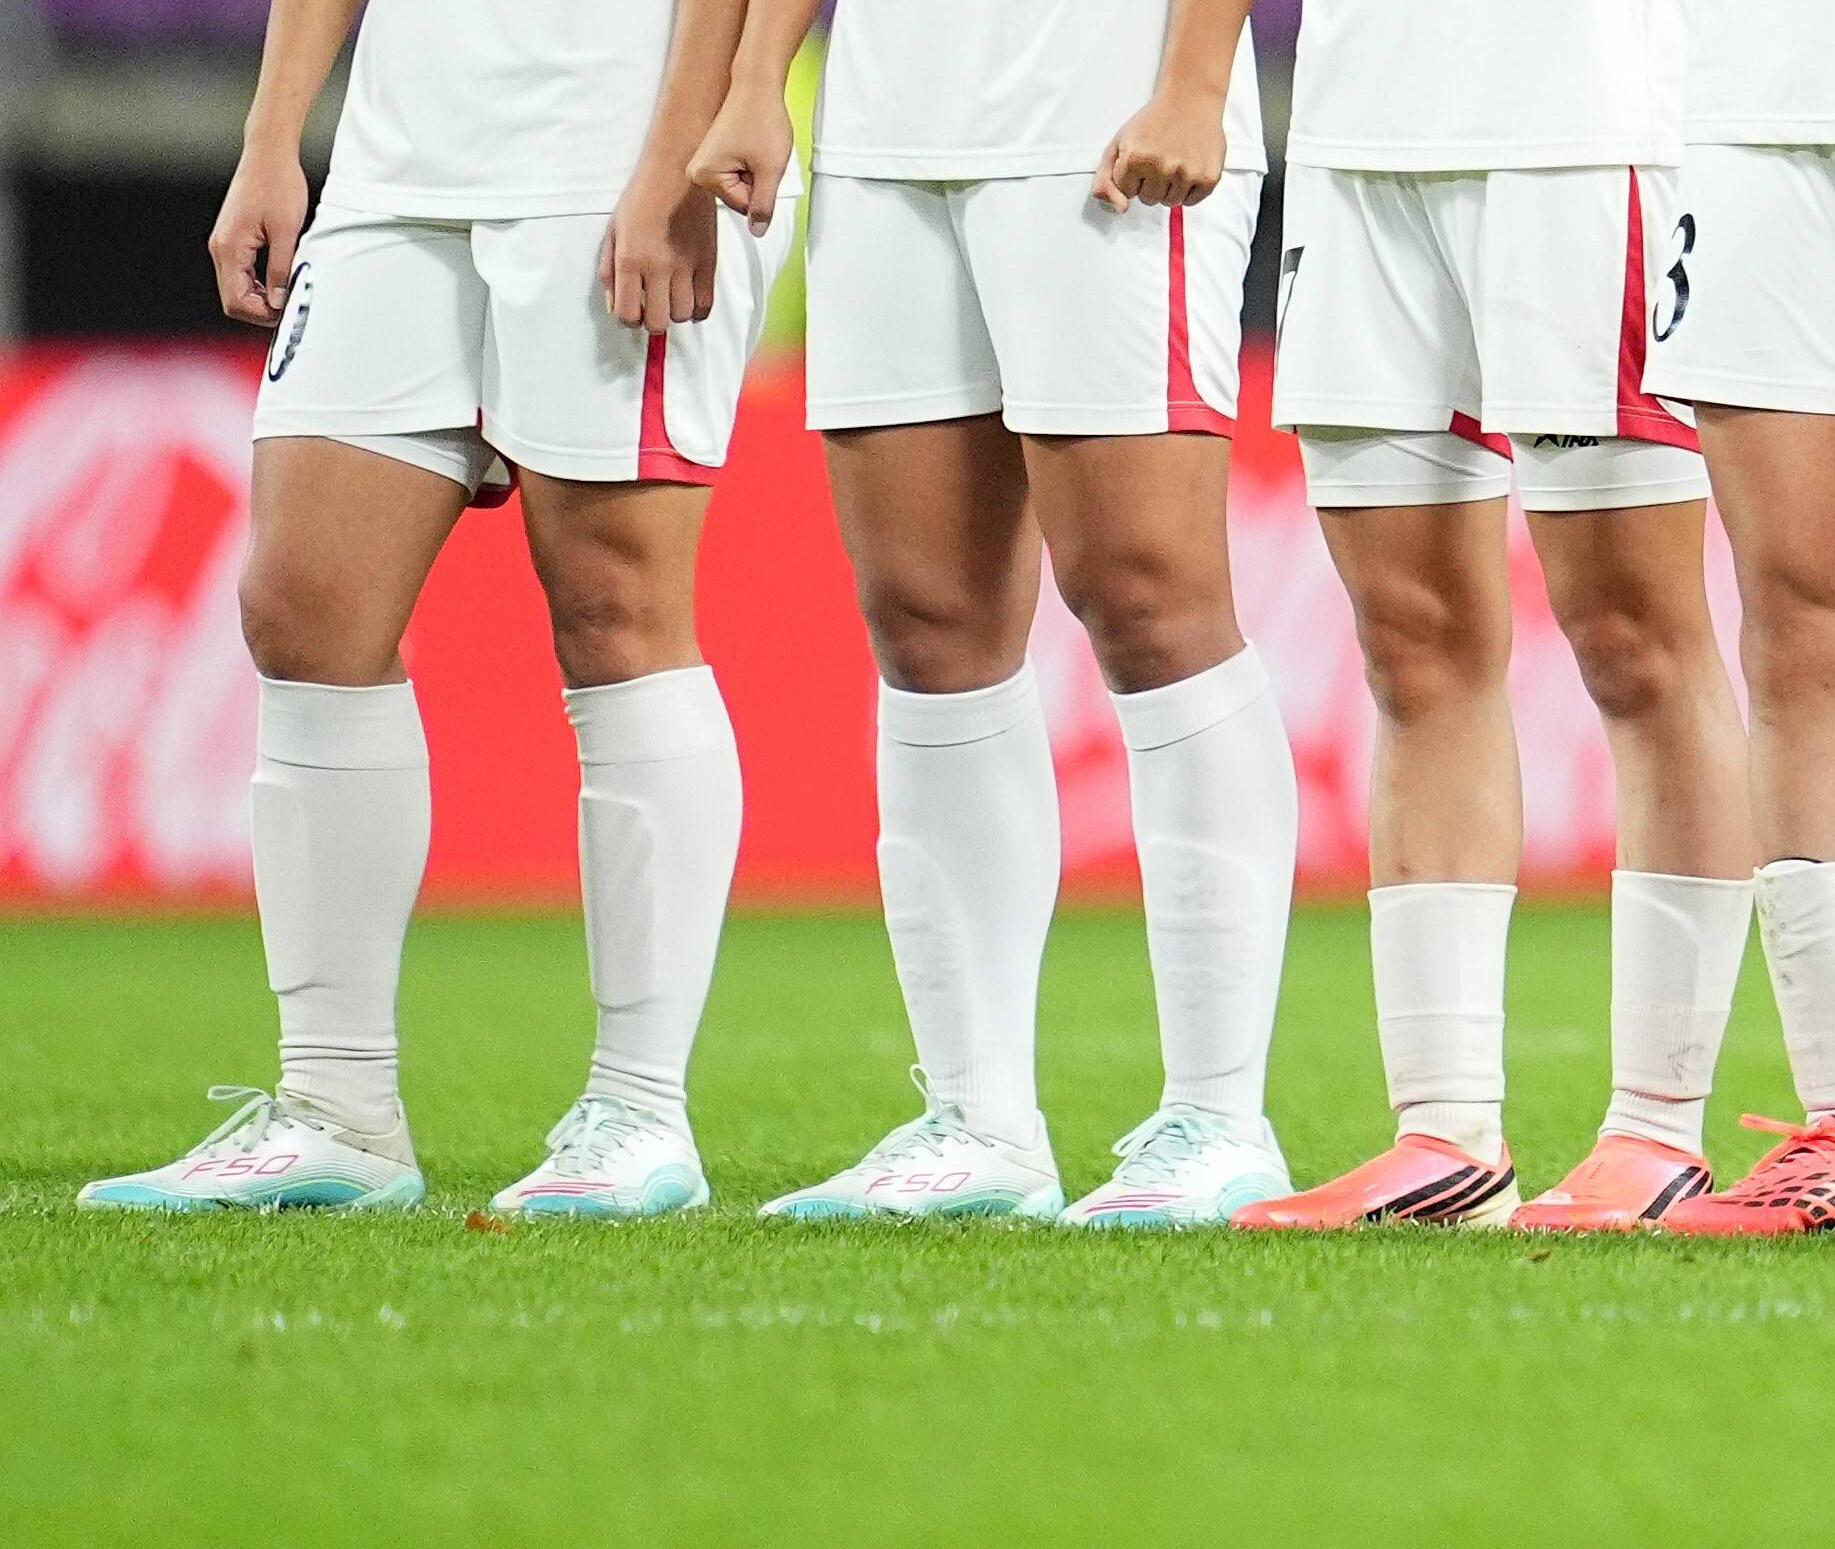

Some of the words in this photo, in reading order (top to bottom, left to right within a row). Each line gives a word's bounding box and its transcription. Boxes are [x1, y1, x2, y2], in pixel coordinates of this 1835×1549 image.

[1653, 213, 1696, 343] 3
[181, 1154, 299, 1181] F50
[865, 1171, 971, 1195] F50
